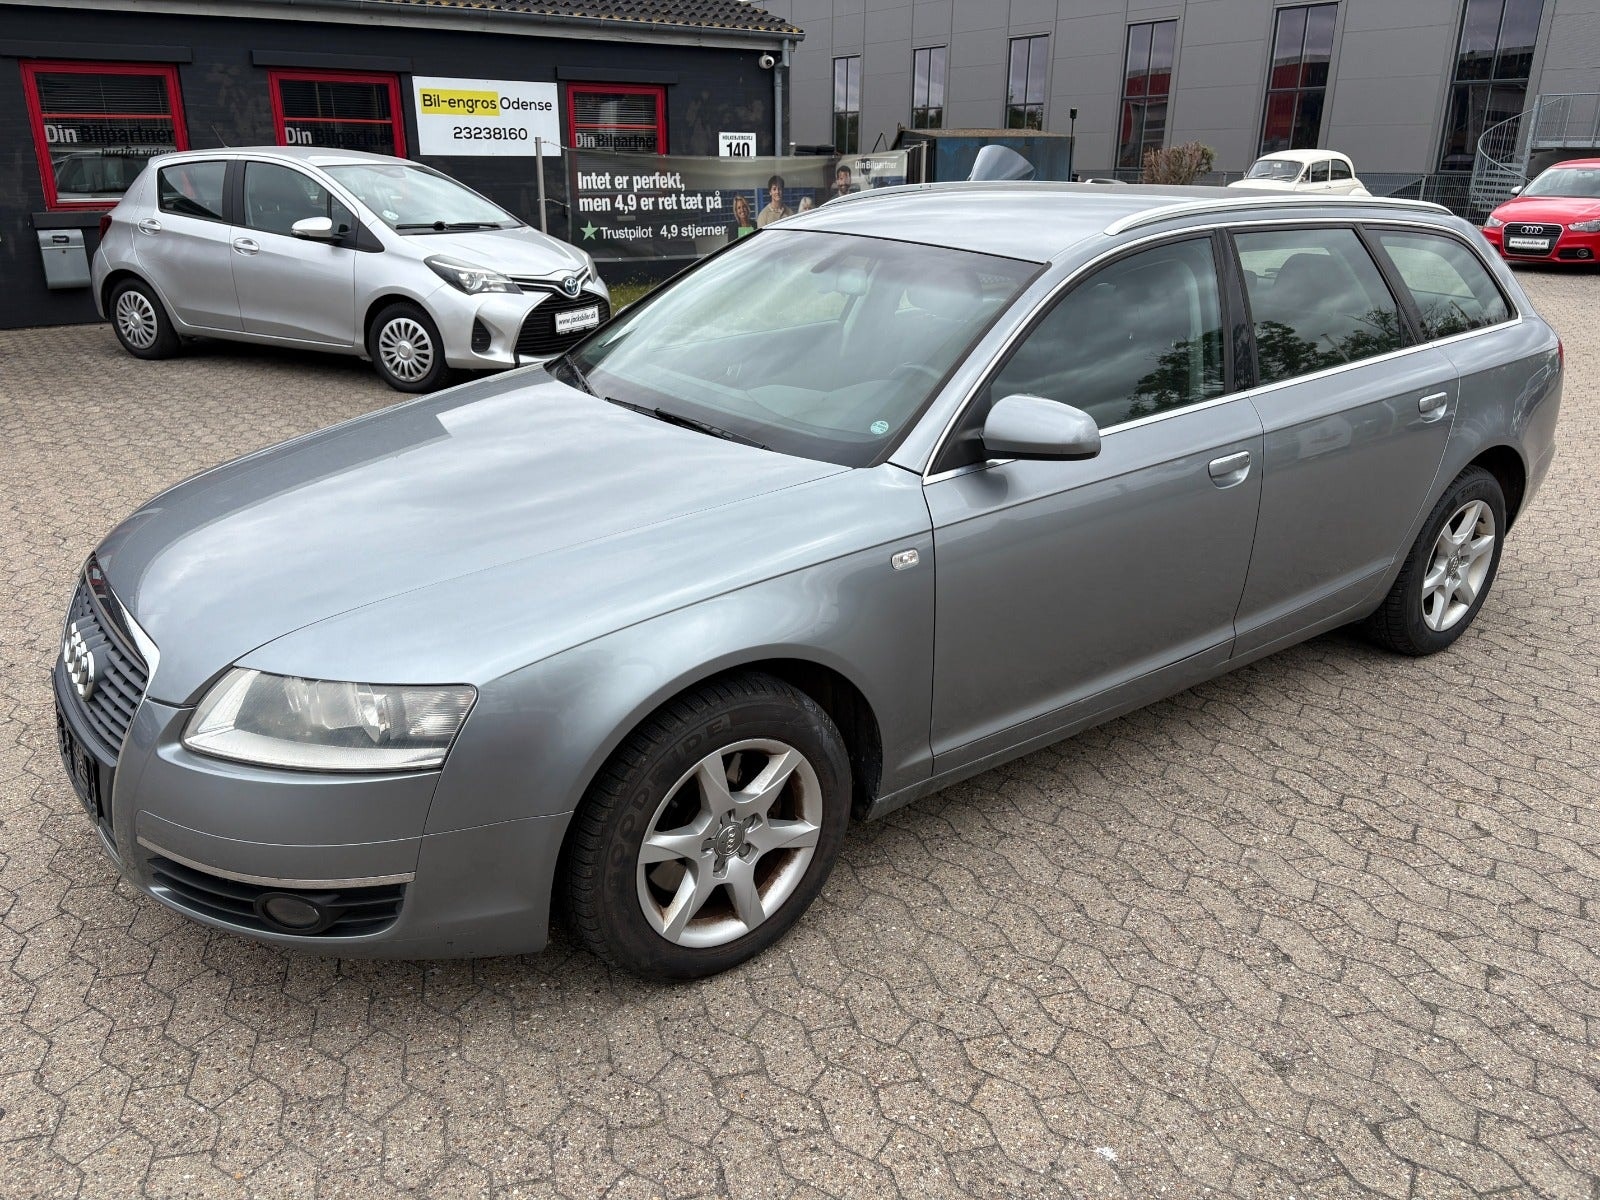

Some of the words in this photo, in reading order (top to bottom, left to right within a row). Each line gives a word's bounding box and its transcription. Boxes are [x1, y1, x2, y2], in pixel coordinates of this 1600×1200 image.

[422, 94, 497, 113] Bil-engros
[499, 96, 553, 112] Odense
[44, 124, 78, 143] Din
[284, 126, 313, 145] Din
[453, 126, 528, 140] 23238160
[575, 133, 596, 148] Din
[597, 133, 657, 151] Bilpartner
[726, 142, 750, 157] 140
[577, 171, 612, 190] Intet
[614, 174, 630, 189] er
[633, 171, 685, 193] perfekt,
[578, 197, 611, 212] men
[614, 194, 637, 214] 4,9
[640, 196, 655, 211] er
[658, 194, 678, 210] ret
[680, 193, 703, 210] tæt
[705, 190, 722, 212] på
[600, 225, 653, 241] Trustpilot
[660, 224, 678, 239] 4,9
[681, 224, 727, 239] stjerner
